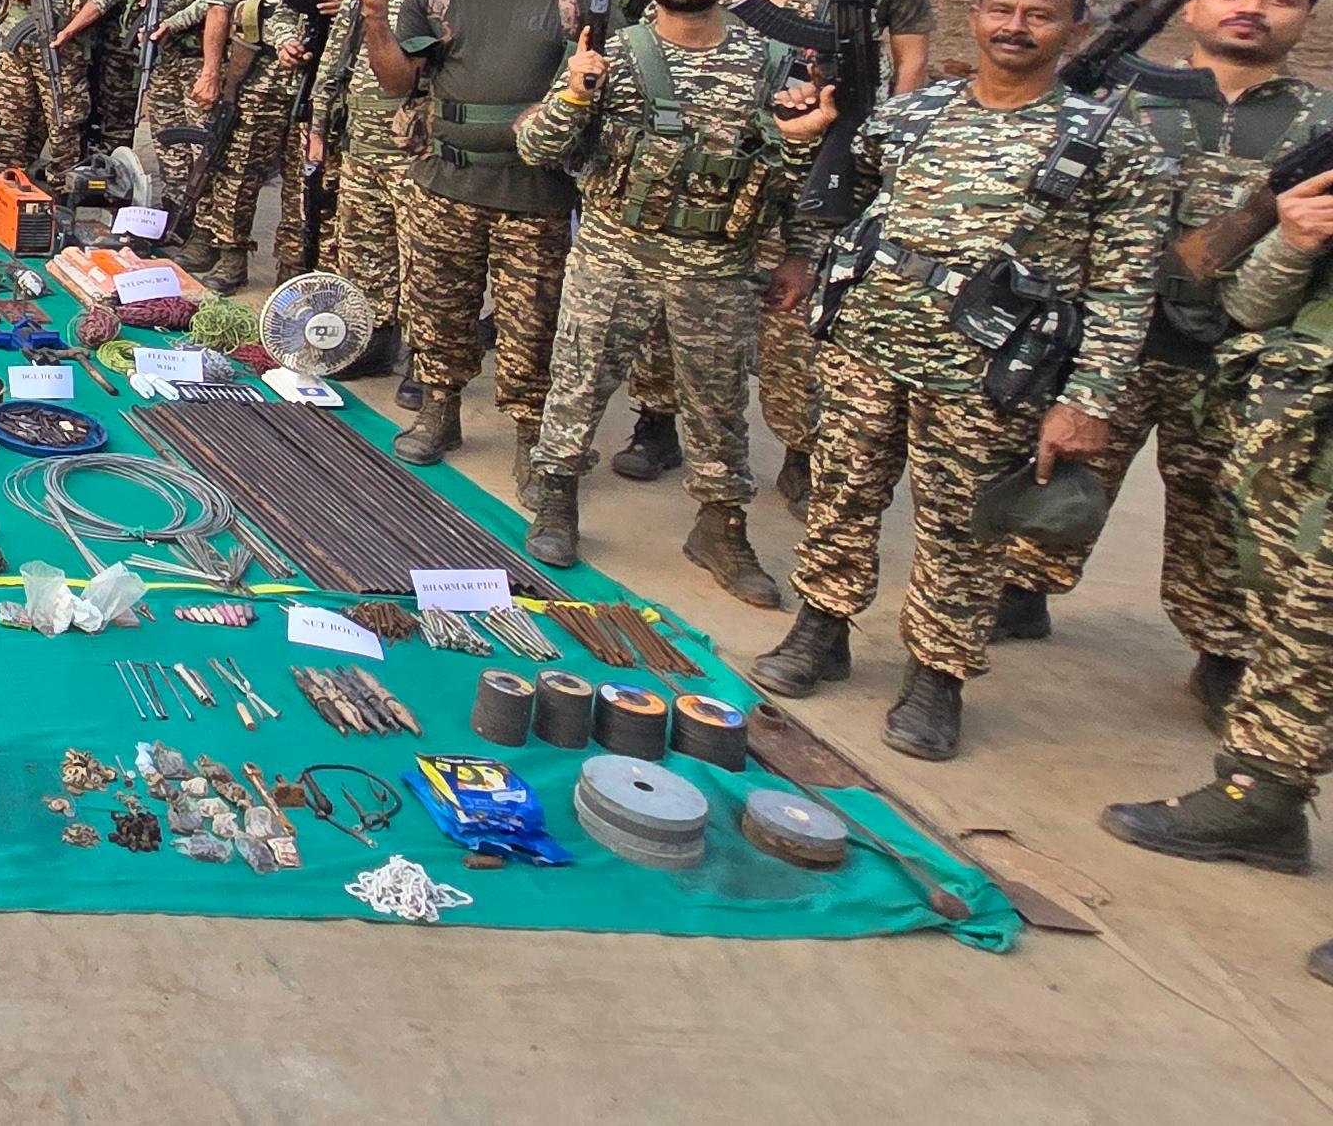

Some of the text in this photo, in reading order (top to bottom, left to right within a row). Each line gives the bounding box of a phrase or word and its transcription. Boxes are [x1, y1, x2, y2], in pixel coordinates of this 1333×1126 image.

[477, 581, 501, 590] PIPE
[301, 618, 361, 638] NUT BOLT
